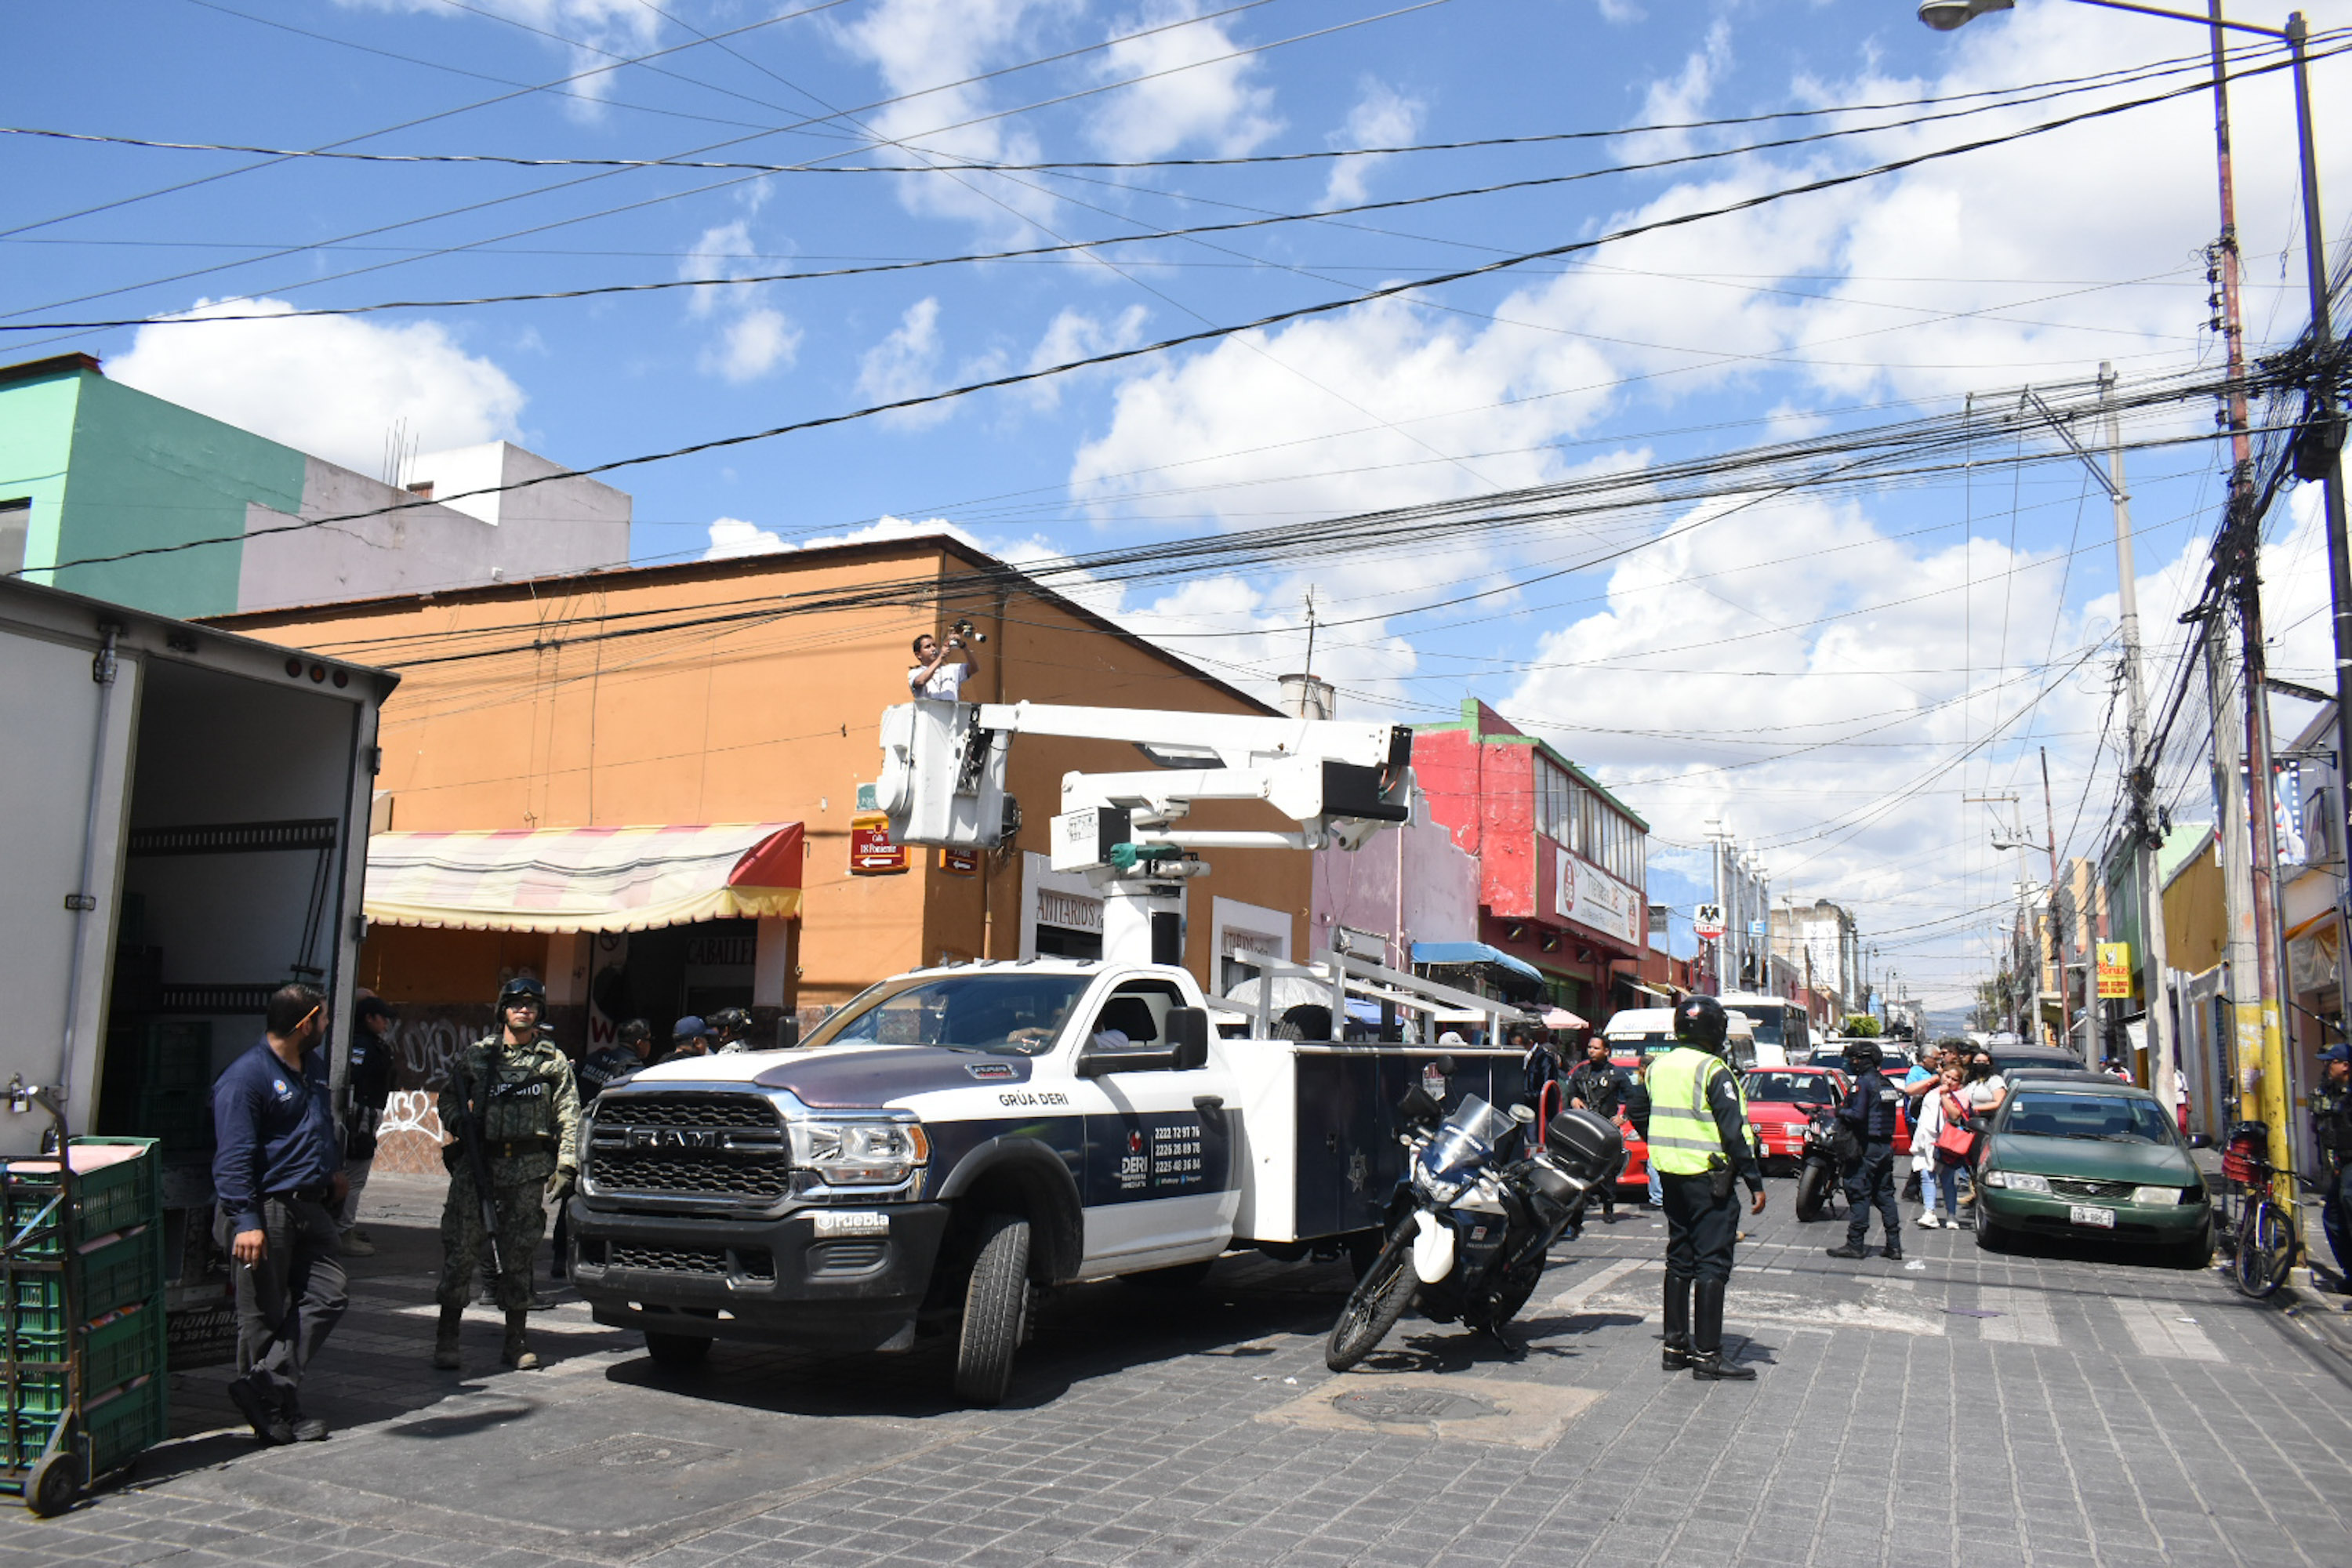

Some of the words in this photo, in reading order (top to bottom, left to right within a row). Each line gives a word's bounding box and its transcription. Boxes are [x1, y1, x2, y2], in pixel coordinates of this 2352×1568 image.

[860, 844, 869, 853] 18
[869, 843, 897, 854] Poniente
[999, 1089, 1039, 1106] GRÚA
[1038, 1092, 1069, 1105] DERI
[632, 1129, 717, 1148] RAM
[1155, 1127, 1171, 1139] 2222
[1121, 1156, 1148, 1174] DERI
[835, 1212, 890, 1228] Puebla
